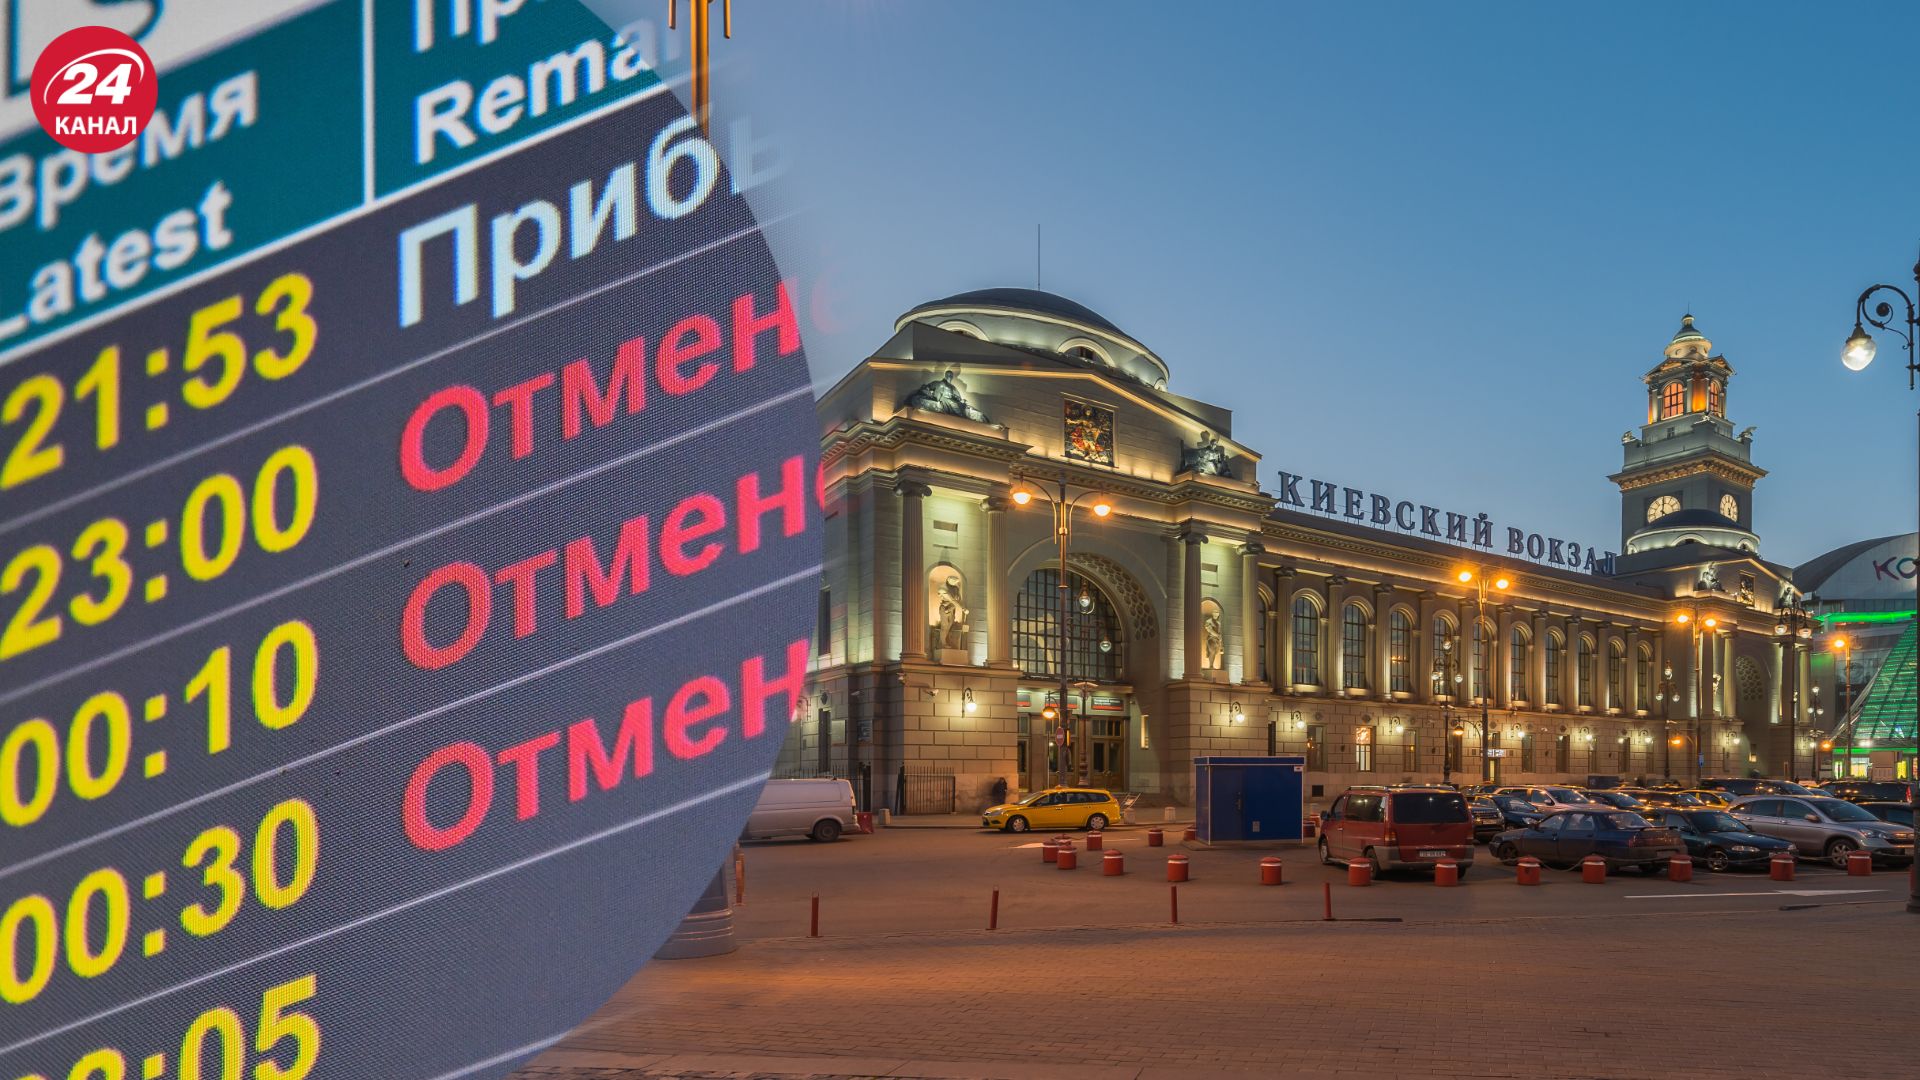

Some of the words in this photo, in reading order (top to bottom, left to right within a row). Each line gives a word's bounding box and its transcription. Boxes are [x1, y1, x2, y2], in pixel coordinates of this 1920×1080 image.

[414, 19, 684, 165] Rema
[1, 273, 317, 489] 21:53
[400, 280, 830, 492] Отмен
[0, 445, 318, 661] 23:00
[400, 455, 826, 671] Отмен
[1278, 470, 1494, 549] КИЕВСКИЙ
[1507, 526, 1617, 576] ВОКЗАЛ
[0, 620, 318, 826] 00:10
[0, 798, 319, 1003] 00:30
